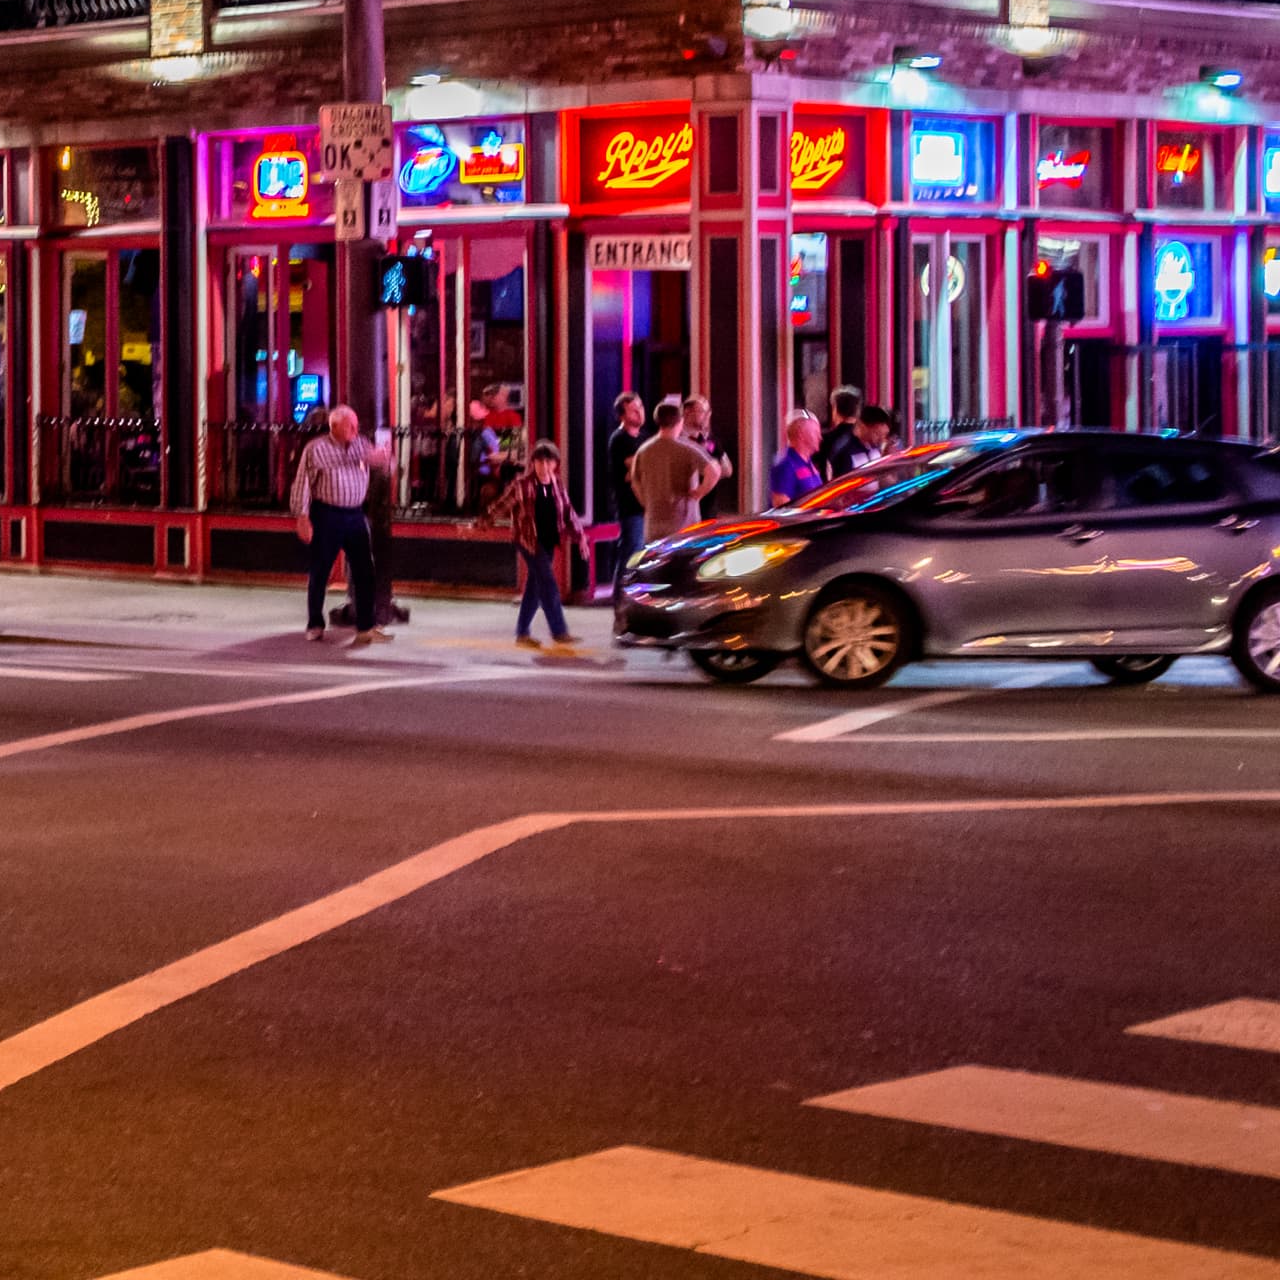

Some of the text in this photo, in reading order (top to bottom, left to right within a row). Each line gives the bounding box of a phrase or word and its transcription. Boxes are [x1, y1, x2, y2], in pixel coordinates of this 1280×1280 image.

[331, 107, 384, 122] DIAGONAL
[331, 121, 386, 138] CROSSING
[324, 144, 353, 170] OK
[597, 123, 693, 185] Rippy's
